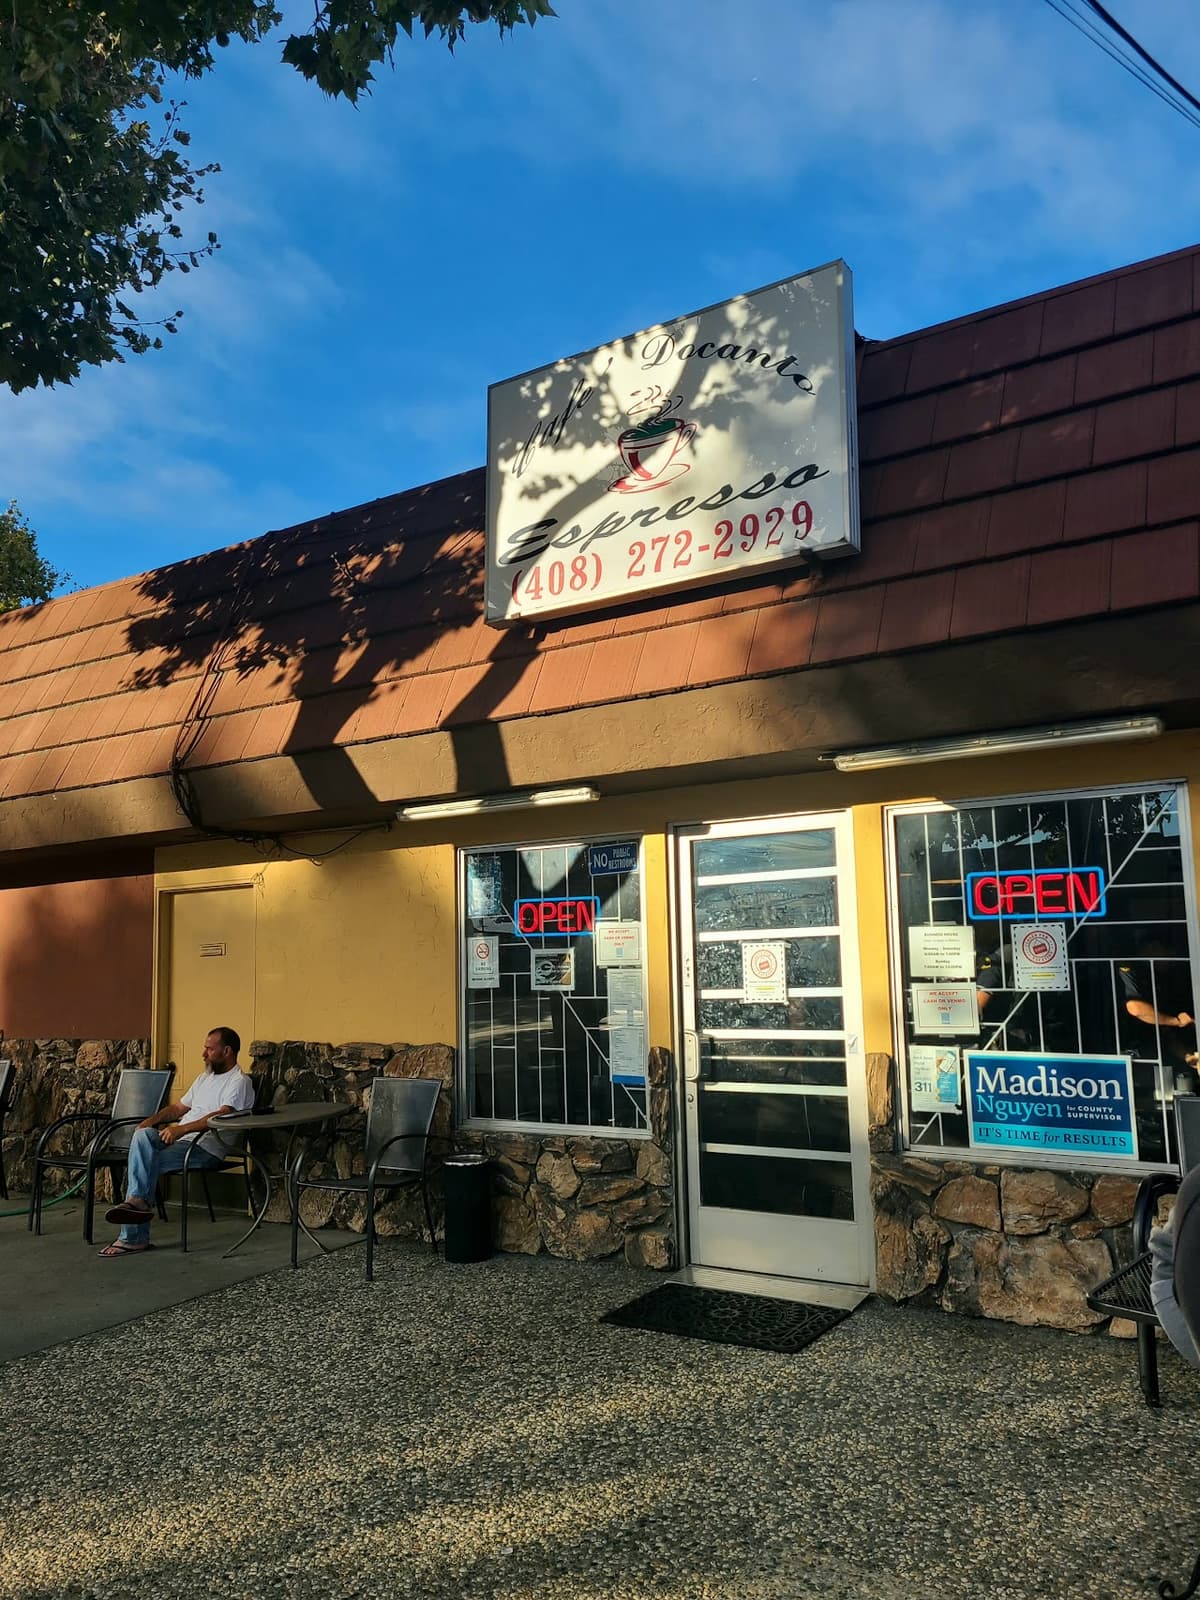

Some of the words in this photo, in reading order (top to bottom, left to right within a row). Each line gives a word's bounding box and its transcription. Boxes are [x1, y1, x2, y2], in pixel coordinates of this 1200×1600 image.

[641, 333, 816, 395] Docanto
[498, 463, 829, 565] Espresso
[511, 552, 603, 606] (408)
[627, 500, 813, 579] 272-2929
[593, 853, 608, 868] NO
[973, 872, 1098, 915] OPEN
[518, 901, 595, 933] OPEN
[914, 1081, 932, 1093] 311
[976, 1065, 1124, 1100] Madison
[976, 1094, 1062, 1122] Nguyen
[1067, 1112, 1122, 1121] SUPERVISOR
[1077, 1105, 1113, 1113] COUNTY
[978, 1127, 1002, 1137] IT'S
[1006, 1129, 1041, 1141] TIME
[1042, 1132, 1060, 1143] for
[1063, 1133, 1127, 1147] RESULTS
